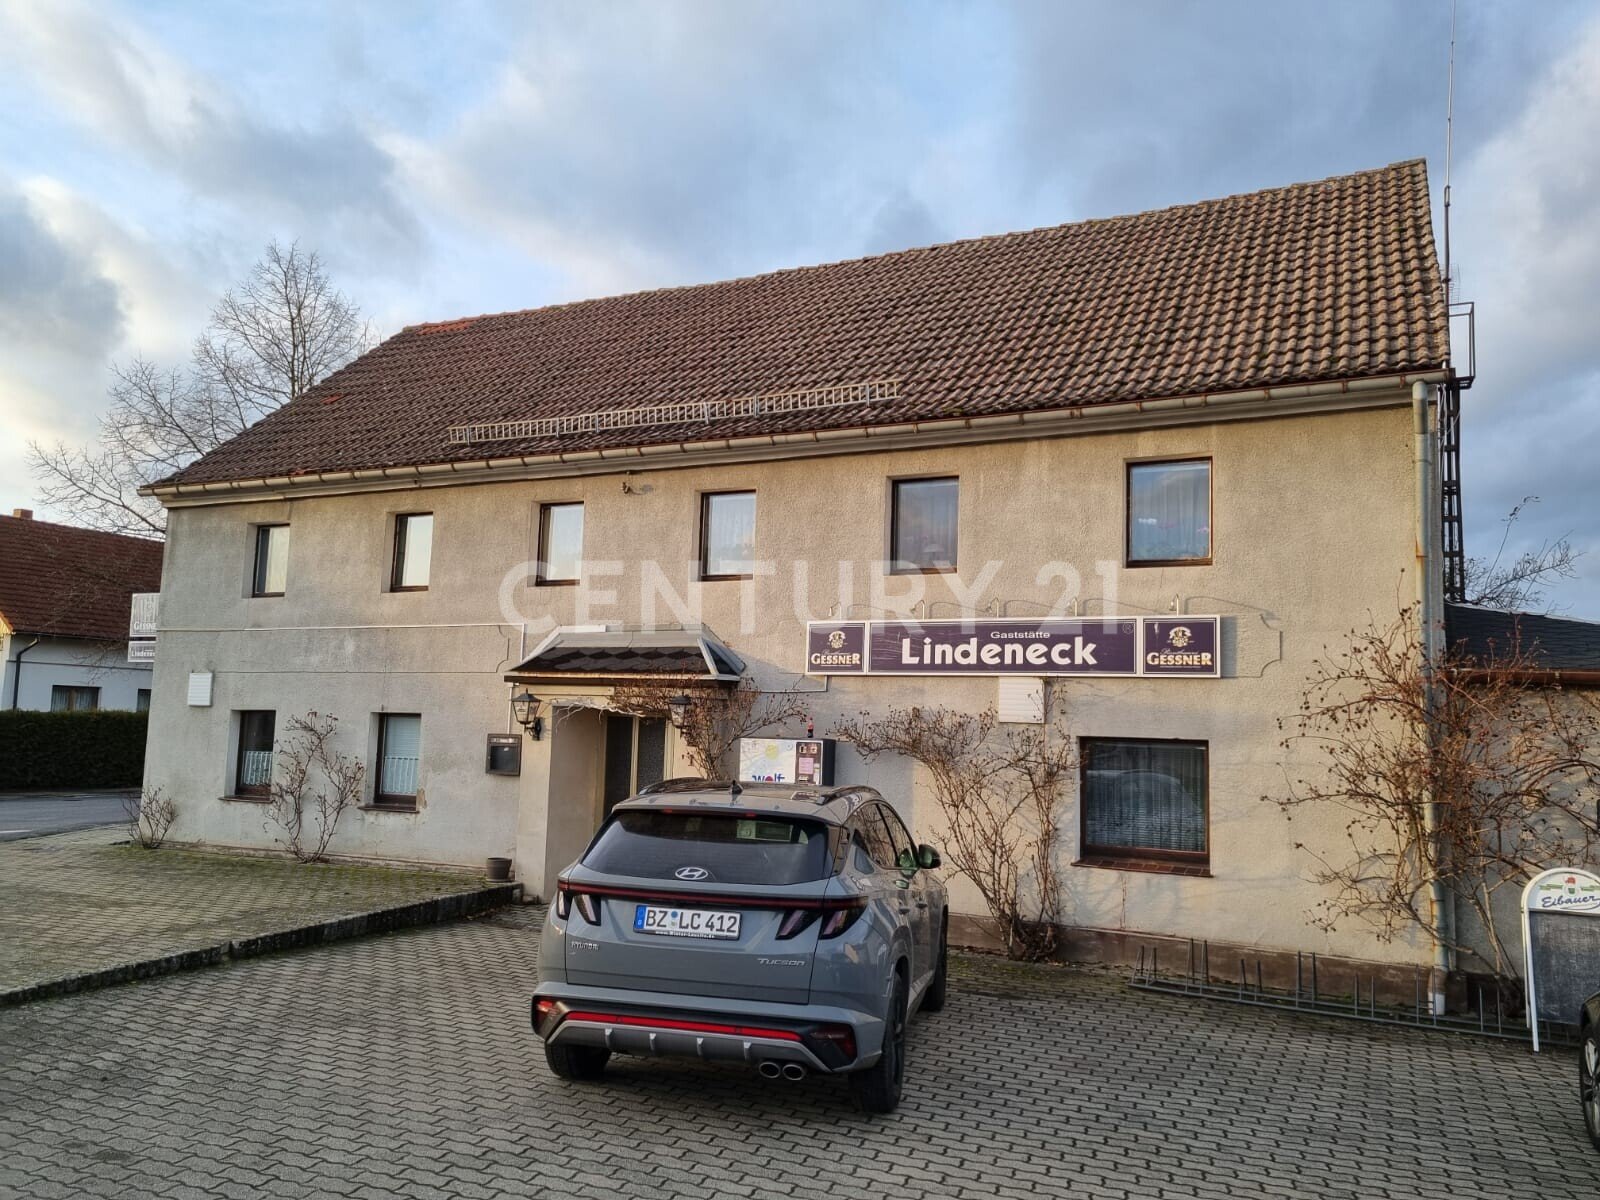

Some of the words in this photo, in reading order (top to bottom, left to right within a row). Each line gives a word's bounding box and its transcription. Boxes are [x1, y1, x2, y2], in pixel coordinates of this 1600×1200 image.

[990, 631, 1051, 640] Gaststätte
[901, 636, 1098, 665] Lindeneck
[810, 653, 861, 665] GESSNER
[1146, 652, 1213, 666] GESSNER
[1541, 895, 1600, 908] Eibauer
[645, 909, 668, 928] BZ
[678, 912, 702, 930] LC
[704, 914, 738, 933] 412
